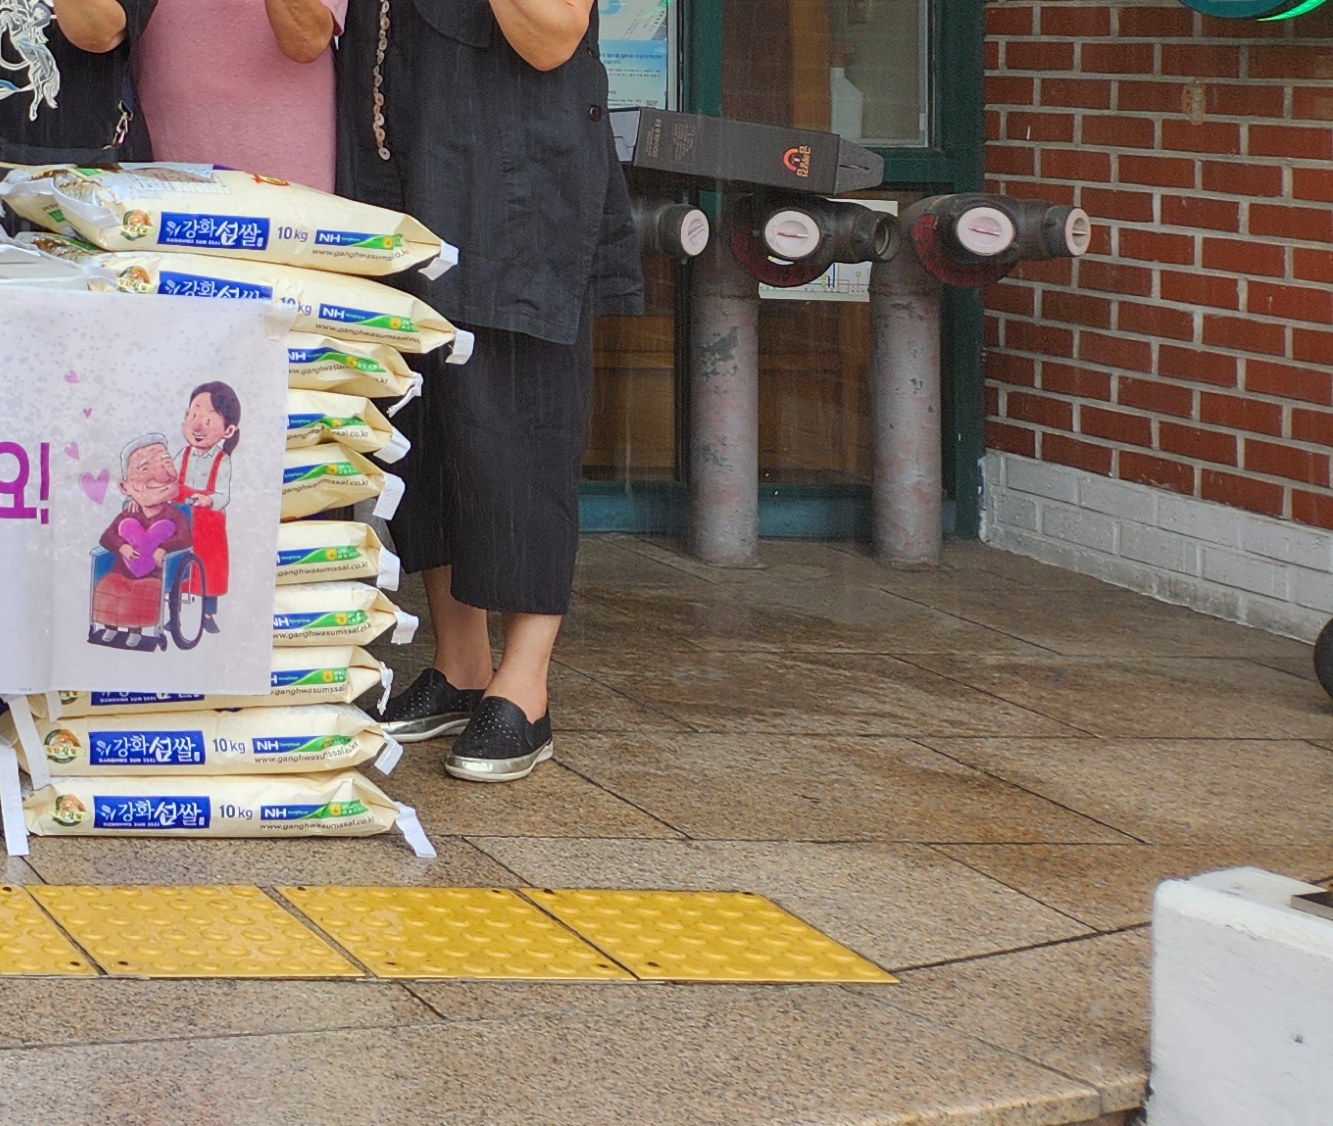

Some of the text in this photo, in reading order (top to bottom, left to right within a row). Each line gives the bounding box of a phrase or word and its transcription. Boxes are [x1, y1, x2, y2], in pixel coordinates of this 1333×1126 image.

[182, 218, 262, 247] 강화섬쌀
[319, 232, 342, 243] NH
[322, 307, 345, 319] NH
[112, 733, 197, 762] 강화섬쌀
[257, 740, 279, 751] NH
[117, 798, 202, 826] 강화섬쌀
[264, 807, 287, 819] NH
